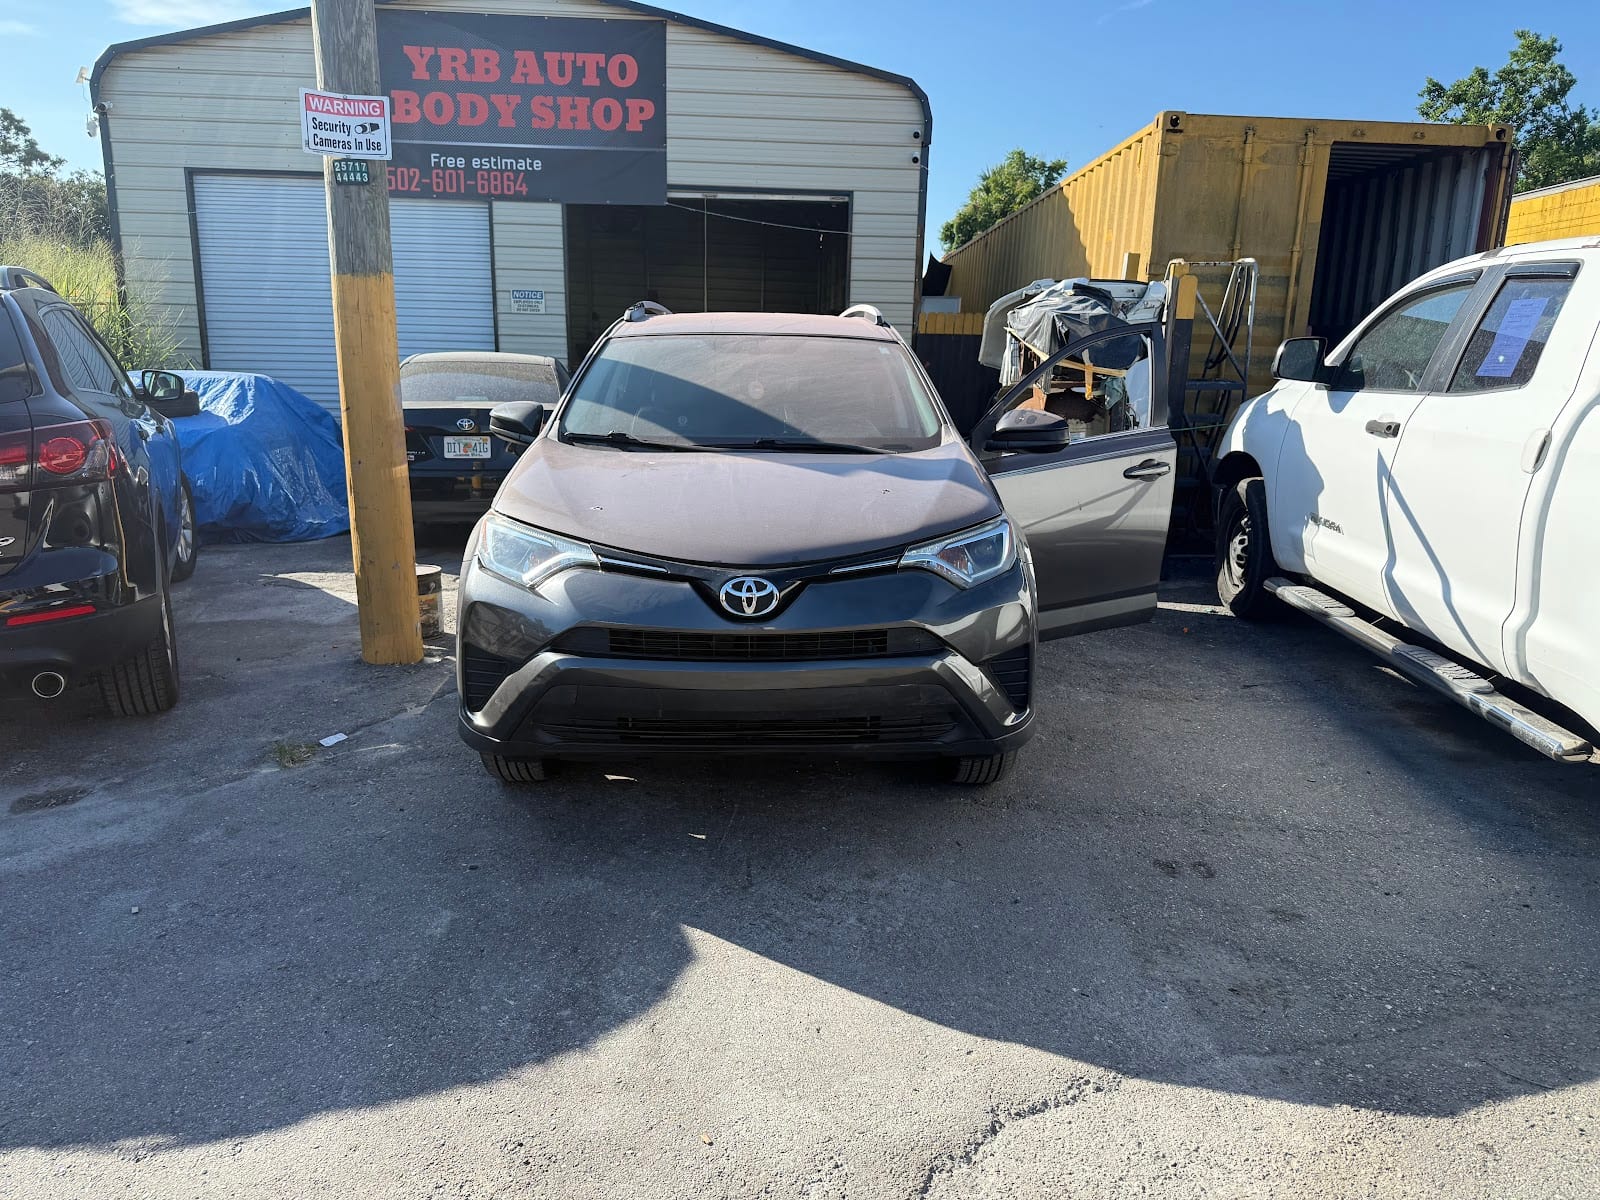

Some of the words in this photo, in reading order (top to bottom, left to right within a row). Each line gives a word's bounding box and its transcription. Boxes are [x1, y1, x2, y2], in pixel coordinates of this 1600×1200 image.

[402, 45, 500, 82] YRB
[510, 50, 639, 87] AUTO
[308, 96, 381, 116] WARNING
[392, 90, 521, 128] BODY
[531, 97, 655, 132] SHOP
[312, 117, 351, 136] Security
[313, 133, 352, 150] Cameras
[354, 138, 363, 150] In
[365, 138, 382, 151] Use
[334, 161, 367, 172] 25717
[430, 153, 466, 168] Free
[471, 156, 542, 171] estimate
[336, 172, 369, 182] 44443
[513, 291, 542, 299] NOTICE
